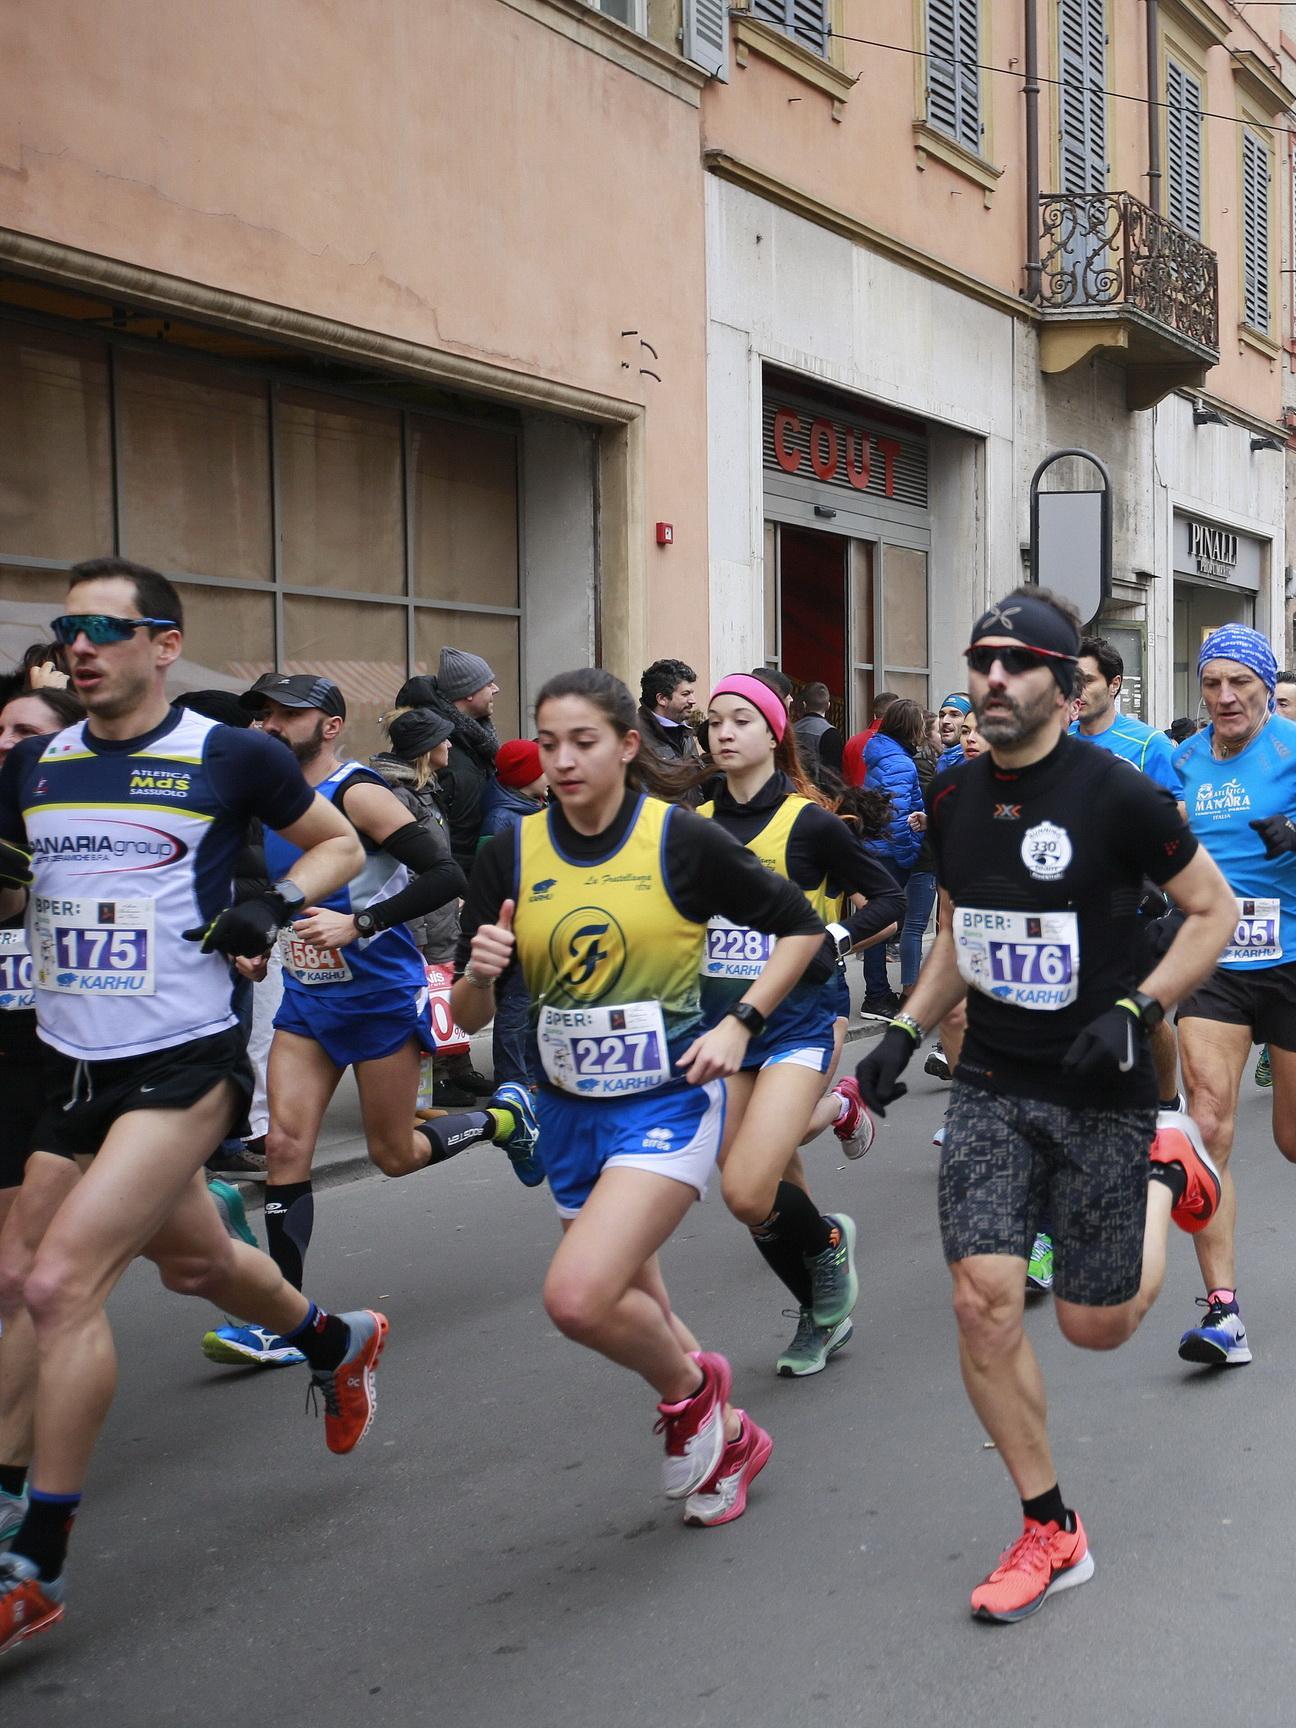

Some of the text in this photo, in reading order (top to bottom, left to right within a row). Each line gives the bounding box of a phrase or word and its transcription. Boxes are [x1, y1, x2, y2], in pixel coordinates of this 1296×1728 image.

[774, 406, 903, 497] COUT
[1190, 522, 1239, 566] PINALLI
[130, 769, 192, 780] ATLETICA
[128, 788, 188, 798] SASSUOLO
[129, 777, 191, 791] MdS
[1194, 795, 1252, 812] MANARA
[1030, 841, 1057, 854] 330
[34, 897, 81, 916] BPER:
[962, 912, 1011, 930] BPER:
[1226, 919, 1268, 947] 05
[62, 930, 137, 970] 175
[710, 930, 763, 961] 228
[1233, 947, 1276, 959] KARHU
[293, 942, 338, 969] 584
[995, 943, 1064, 985] 176
[79, 975, 145, 991] KARHU
[306, 970, 345, 981] KARHU
[1014, 988, 1072, 1004] KARHU
[545, 1010, 592, 1027] BPER:
[576, 1033, 649, 1075] 227
[602, 1074, 663, 1093] KARHU
